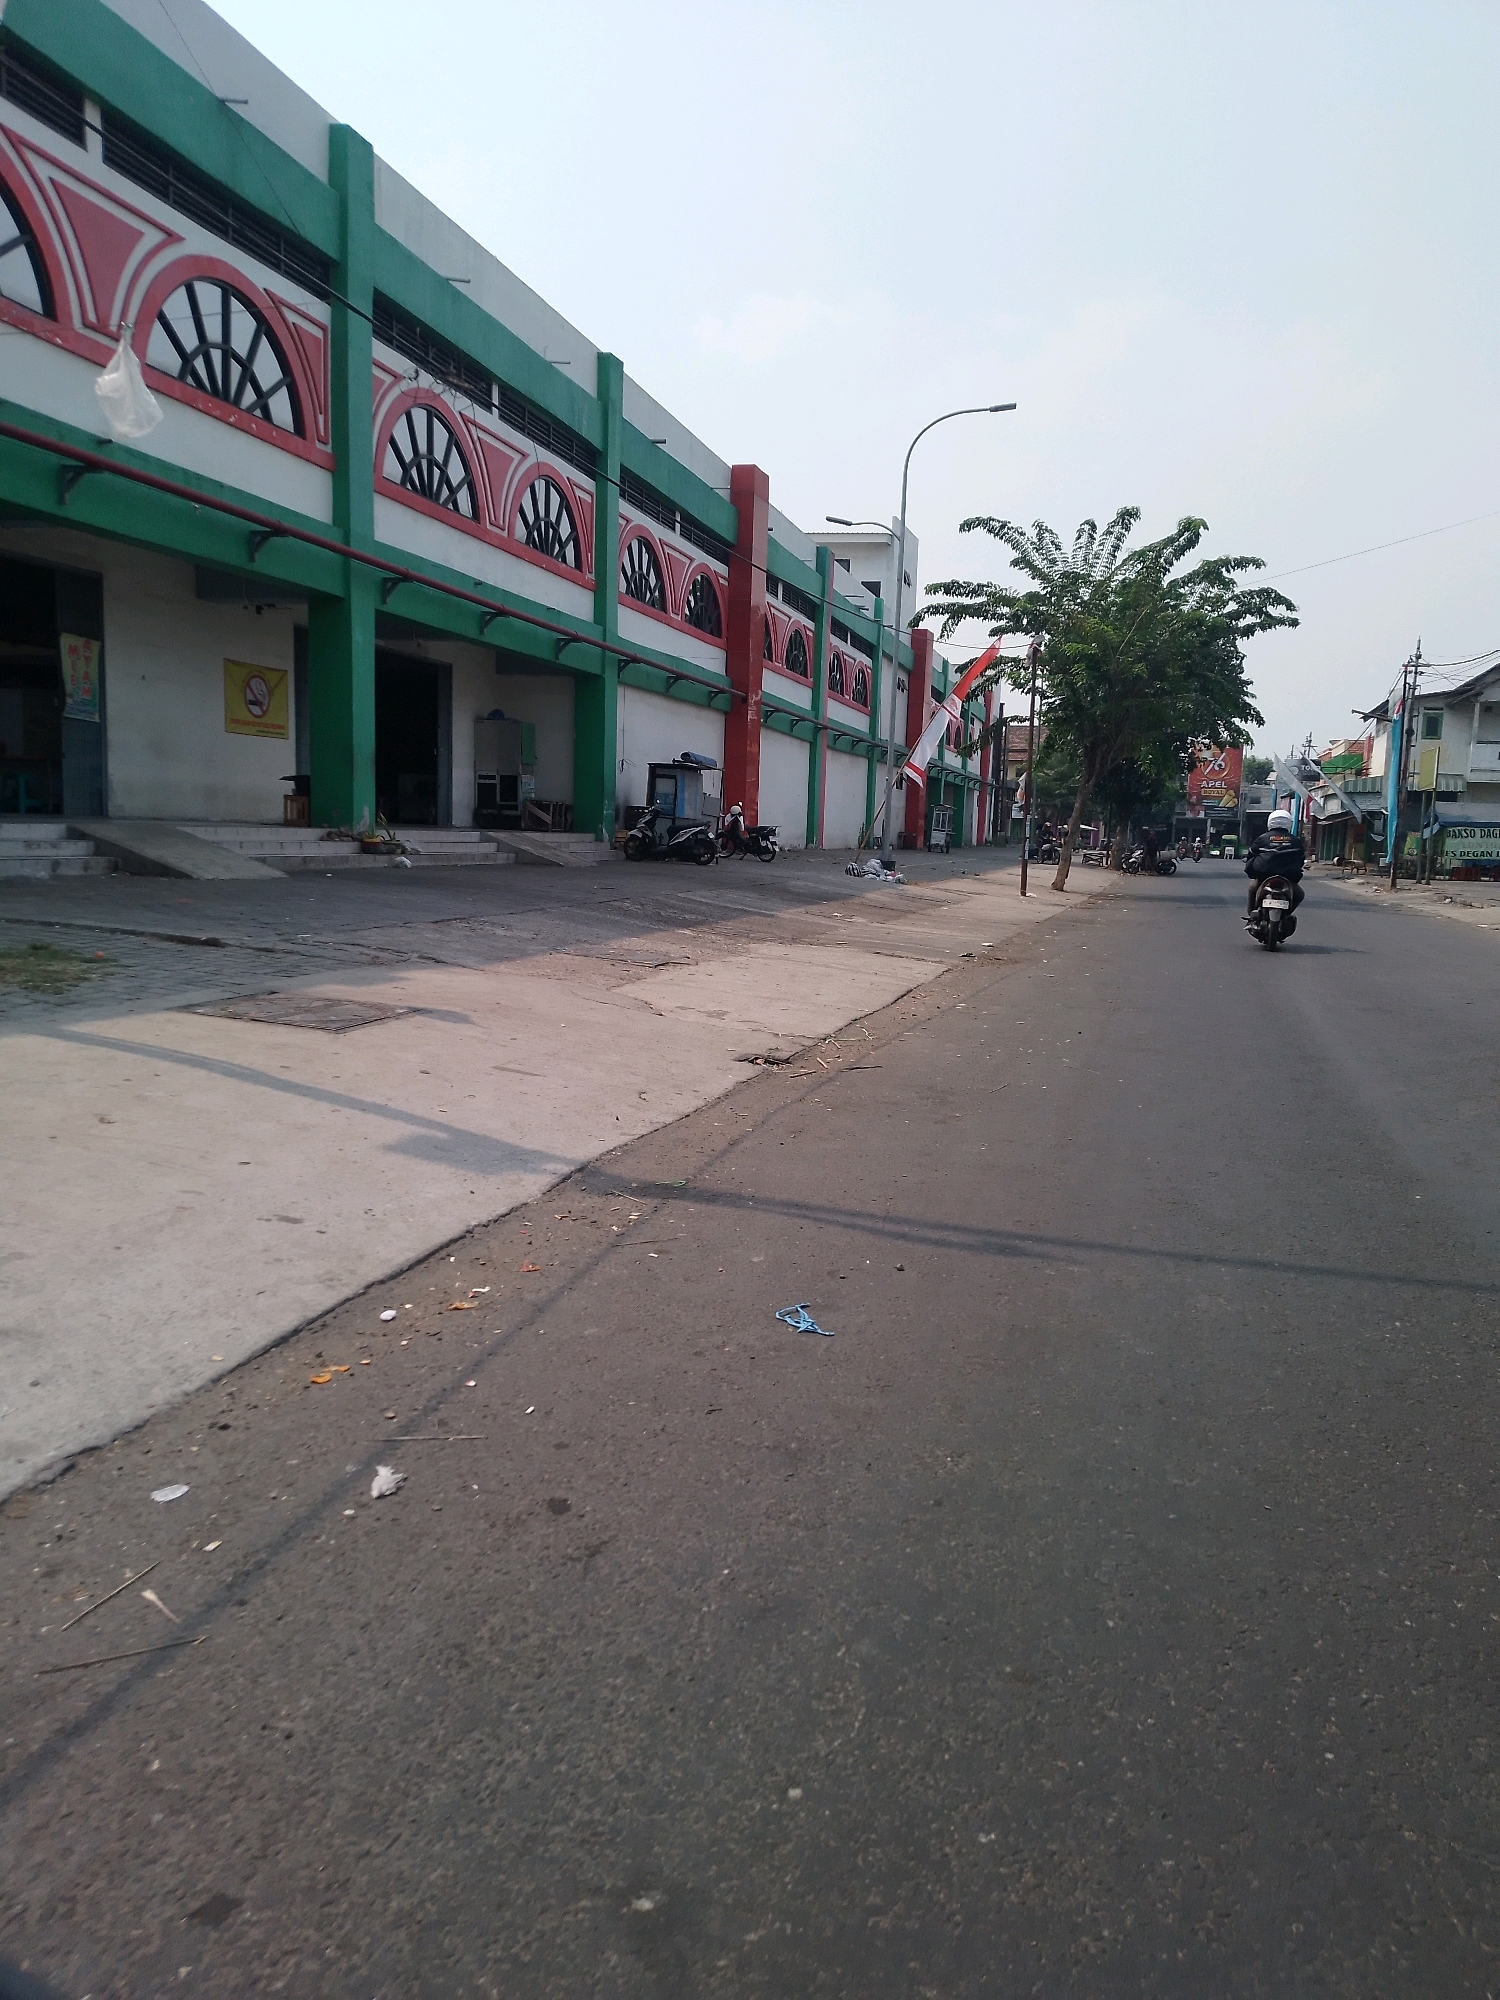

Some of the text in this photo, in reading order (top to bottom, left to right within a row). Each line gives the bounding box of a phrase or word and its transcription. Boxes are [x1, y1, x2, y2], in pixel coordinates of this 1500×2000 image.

[68, 643, 79, 688] MIE
[81, 639, 92, 700] AYAM
[1200, 780, 1227, 788] APEL
[1446, 828, 1476, 838] BAKSO
[1459, 850, 1493, 858] DEGAN
